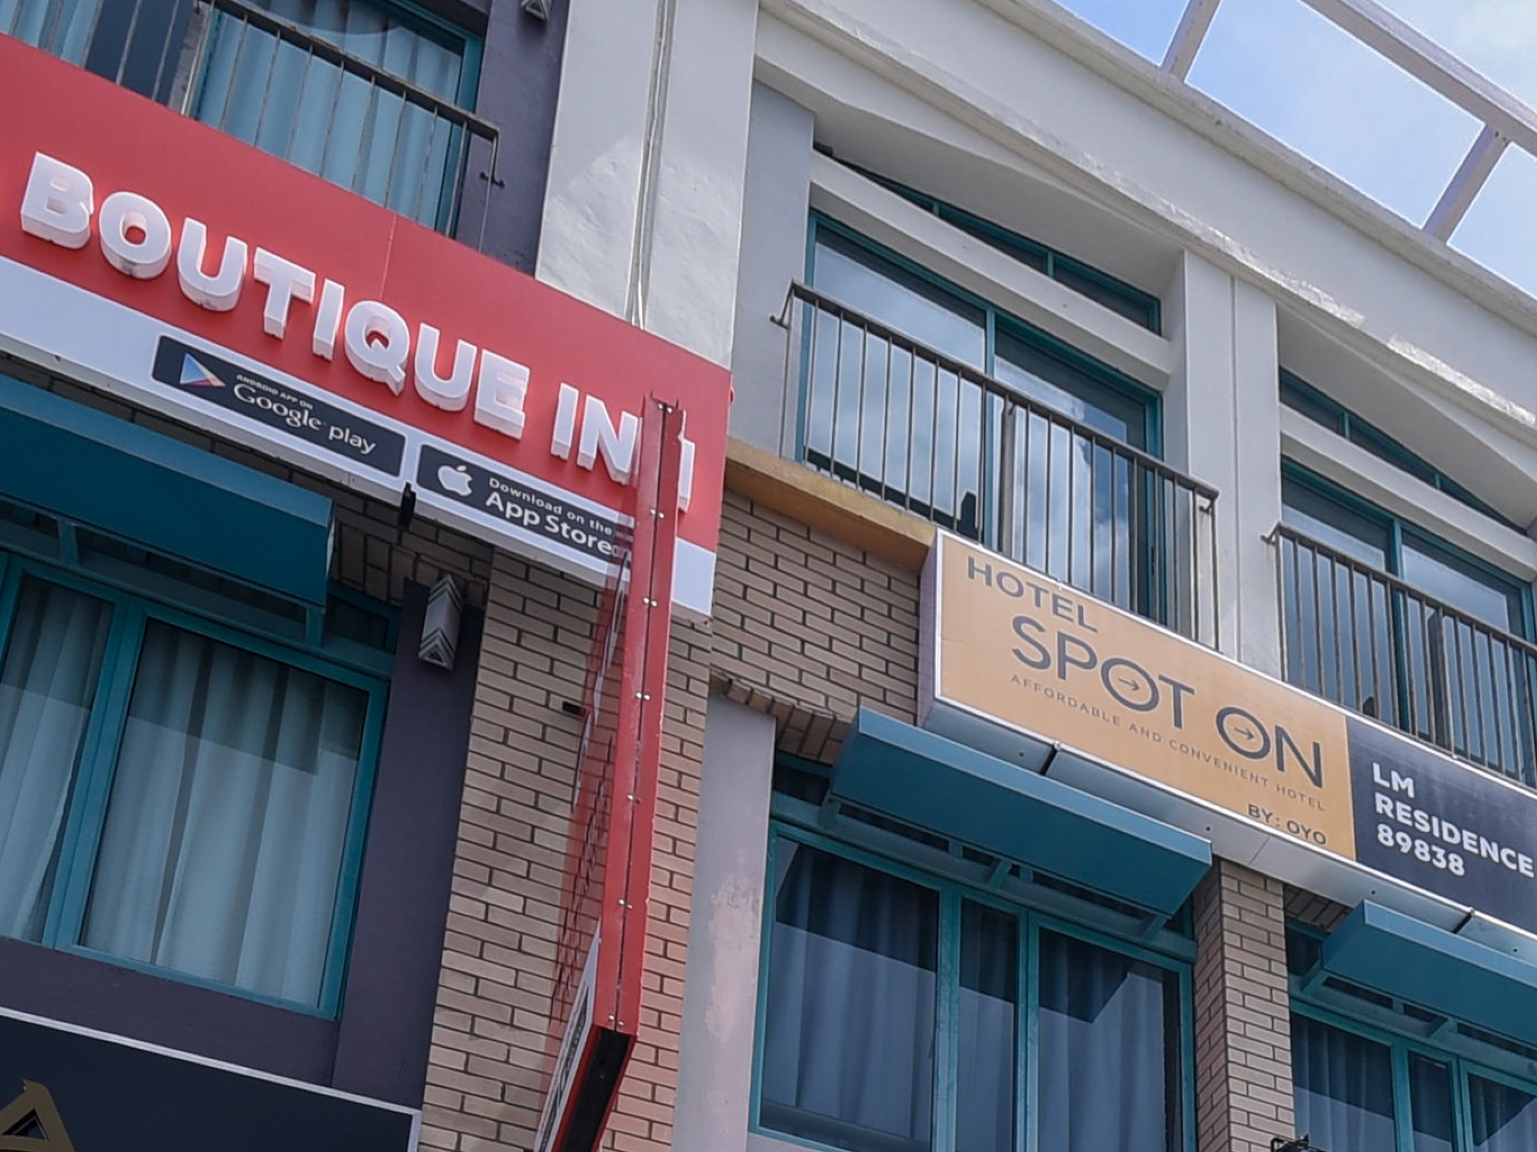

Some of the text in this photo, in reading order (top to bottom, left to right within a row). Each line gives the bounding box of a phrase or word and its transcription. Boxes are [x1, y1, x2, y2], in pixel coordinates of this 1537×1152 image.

[20, 151, 695, 513] BOUTIQUE IN
[233, 383, 376, 455] Google play
[236, 374, 313, 410] ANDROID APP ON
[485, 492, 614, 556] App Store
[489, 476, 613, 536] Download on the
[967, 556, 1098, 633] HOTEL
[1011, 614, 1325, 789] SPOT ON
[1010, 672, 1325, 812] AFFORDABLE AND CONVENIENT HOTEL
[1372, 761, 1416, 799] LM
[1286, 820, 1328, 846] OYO
[1375, 791, 1536, 879] RESIDENCE
[1376, 822, 1467, 877] 89838
